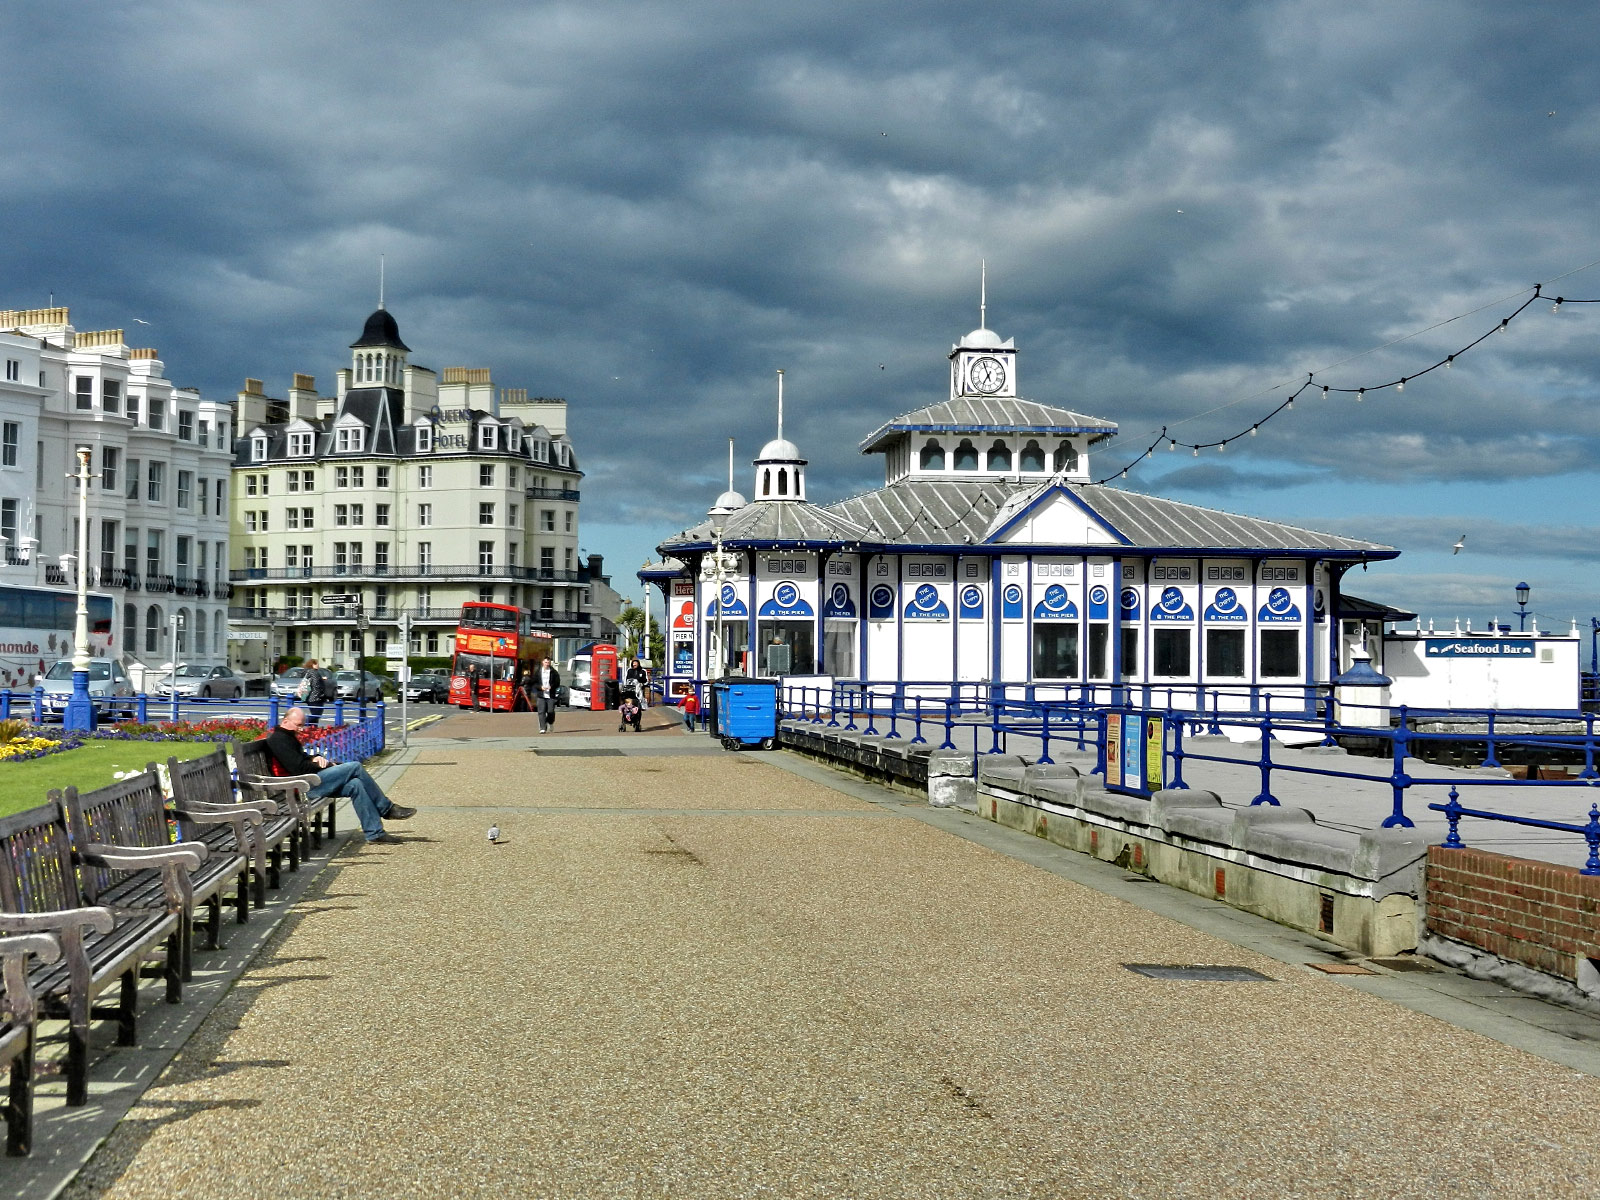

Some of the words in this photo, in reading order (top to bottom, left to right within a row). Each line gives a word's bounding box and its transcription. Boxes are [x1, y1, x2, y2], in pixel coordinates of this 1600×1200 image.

[431, 405, 472, 429] QUEENS
[432, 430, 468, 448] HOTEL
[919, 587, 930, 596] THE
[1165, 591, 1176, 599] THE
[1218, 591, 1229, 599] THE
[919, 592, 936, 604] CHIPPY
[1164, 595, 1181, 608] CHIPPY
[1218, 595, 1235, 608] CHIPPY
[1272, 596, 1288, 608] CHIPPY
[1454, 644, 1500, 654] Seafood
[1503, 644, 1521, 654] Bar
